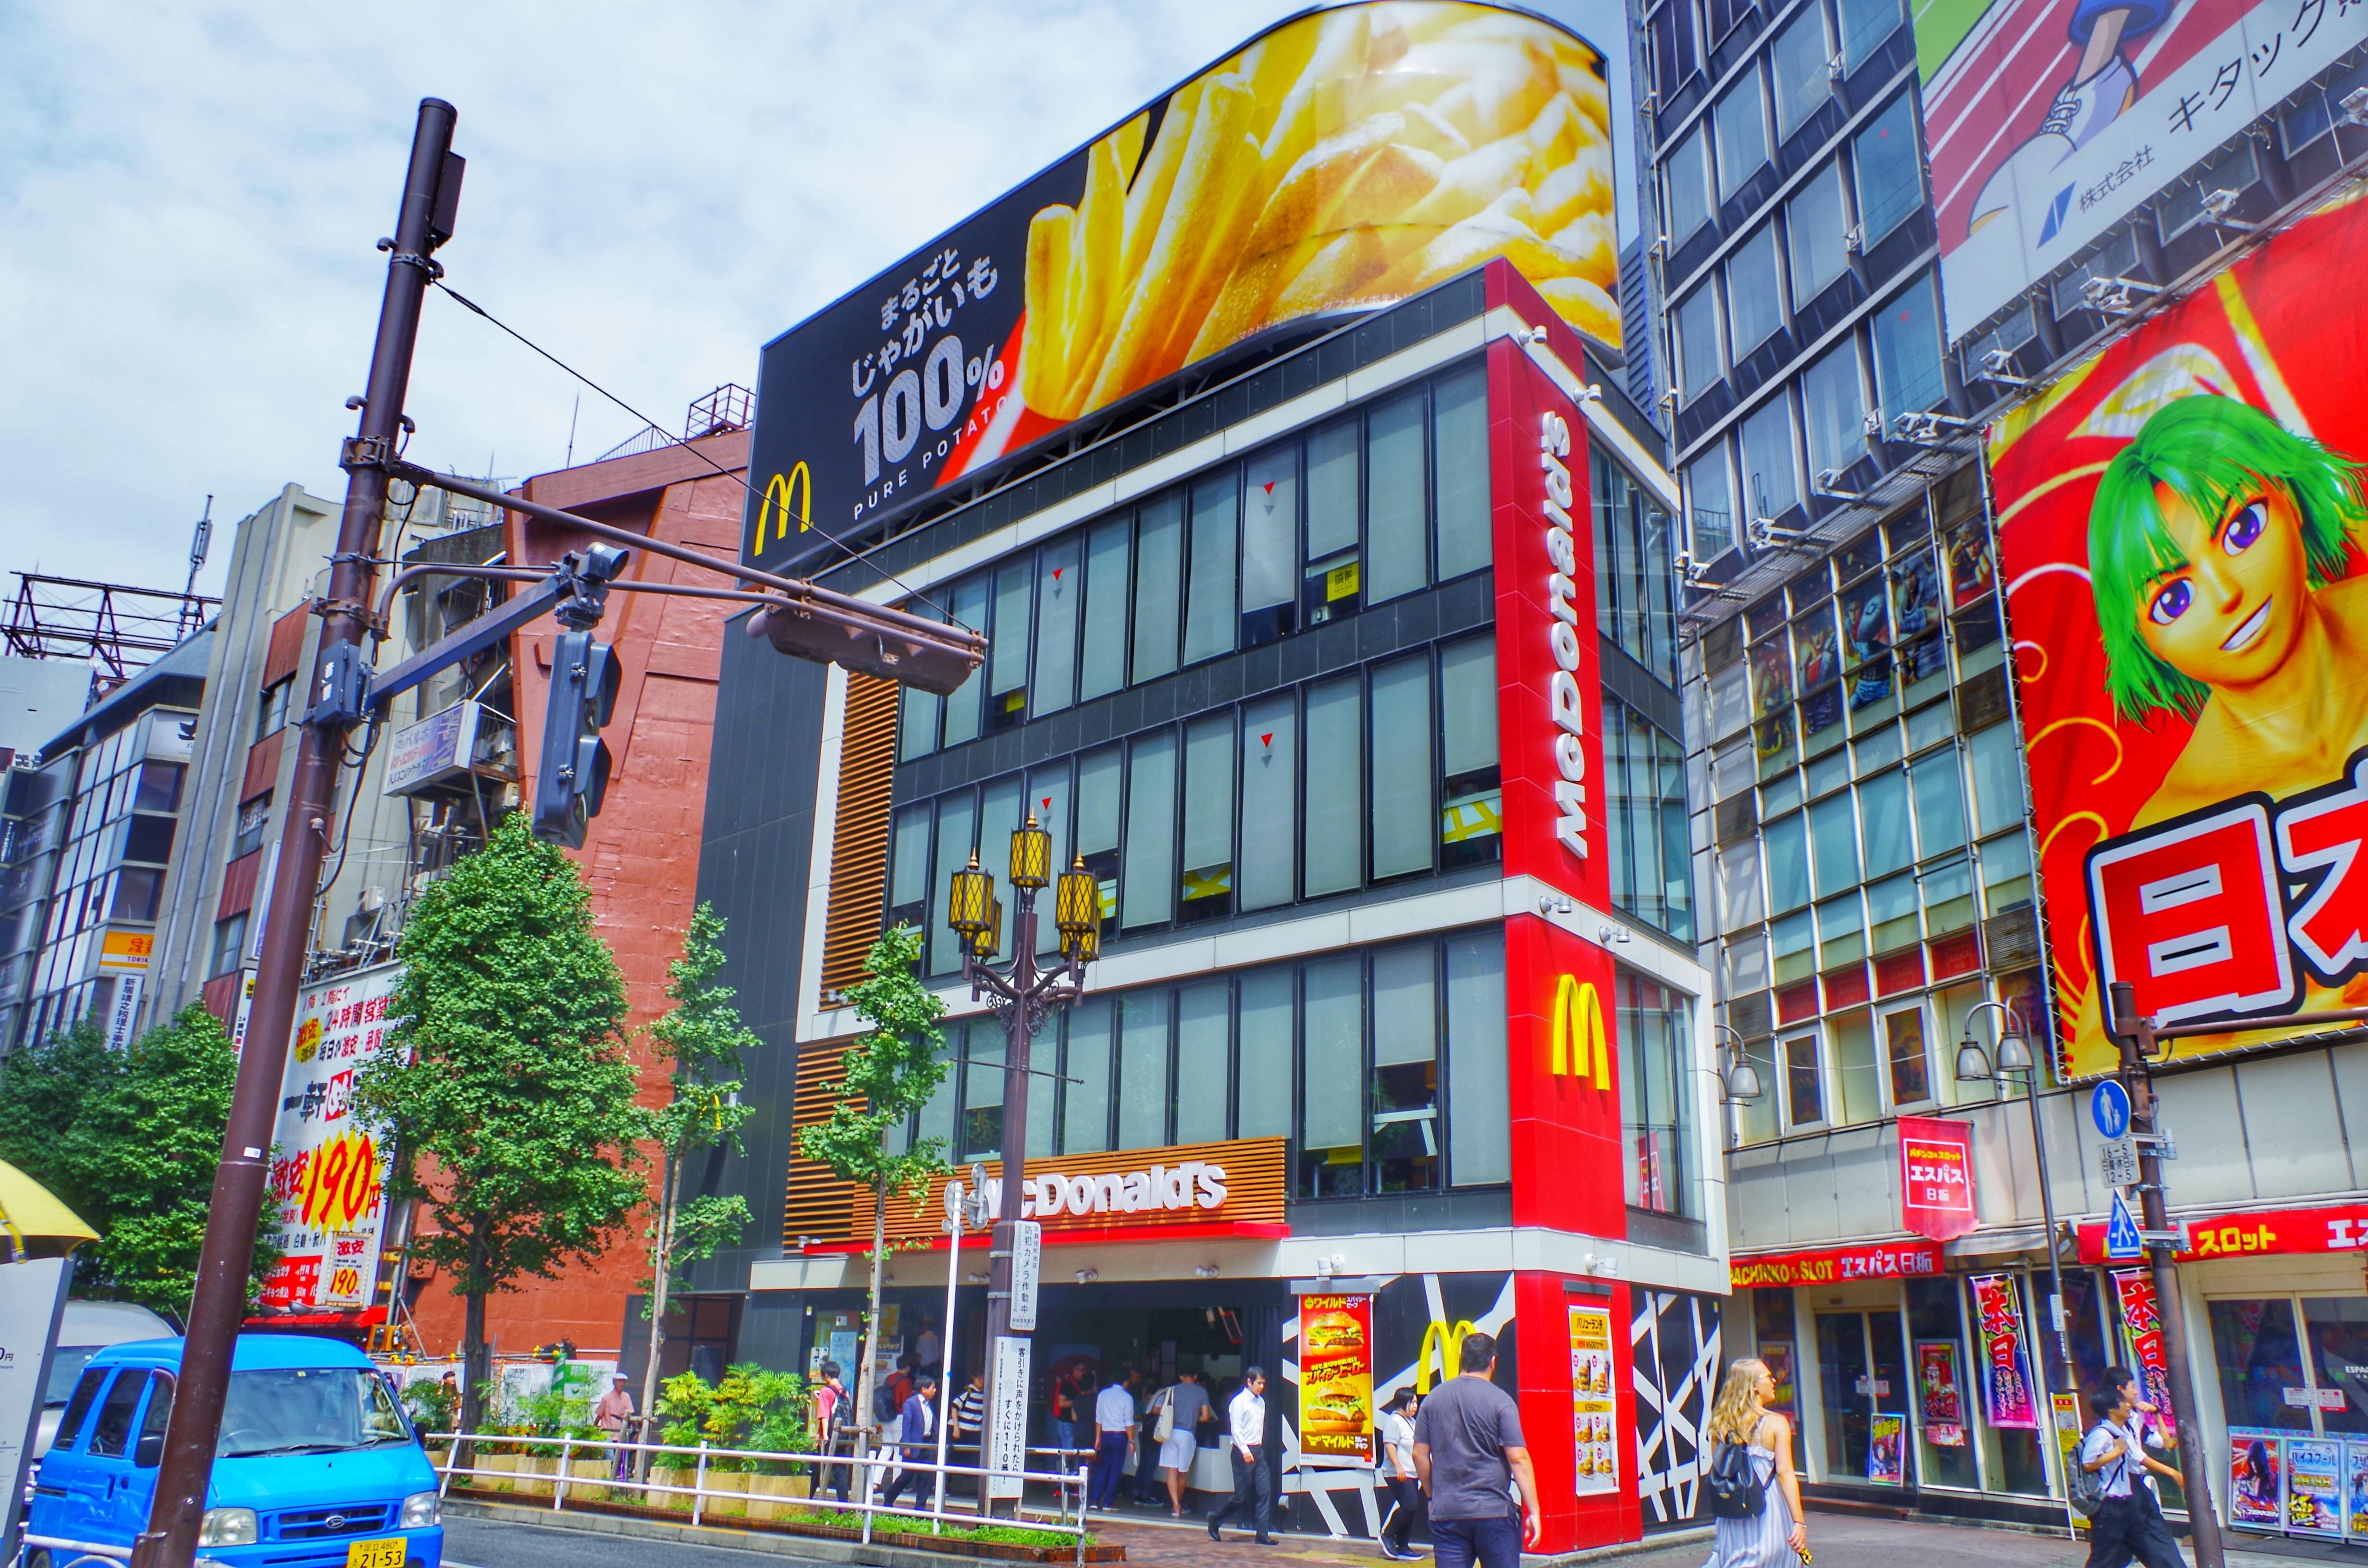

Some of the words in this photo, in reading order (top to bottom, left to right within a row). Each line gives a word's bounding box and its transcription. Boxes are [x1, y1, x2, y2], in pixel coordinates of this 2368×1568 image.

[2079, 145, 2154, 214] 株式会社
[2169, 0, 2361, 135] キタック
[881, 248, 960, 331] まるごと
[852, 256, 998, 398] じゃがいも
[854, 335, 1004, 487] 100%
[854, 469, 907, 520] PURE
[923, 395, 1006, 468] POTATO
[1541, 410, 1589, 860] McDonald's
[324, 995, 389, 1032] 24時間営業
[1910, 1164, 1964, 1185] エスパス
[1021, 1225, 1033, 1314] 防犯カメラ作動中
[1800, 1260, 1833, 1281] SLOT
[1841, 1250, 1933, 1278] エスパス日拓
[1314, 1297, 1346, 1309] ワイルド
[1577, 1317, 1603, 1330] バリューランチ
[1980, 1288, 2017, 1371] 本日
[1306, 1361, 1365, 1385] スパイシーヒーロー
[1012, 1347, 1026, 1472] 客引きに声をかけられたら
[1321, 1435, 1355, 1449] マイルド
[360, 1551, 402, 1568] 21-53
[381, 1541, 395, 1549] 480
